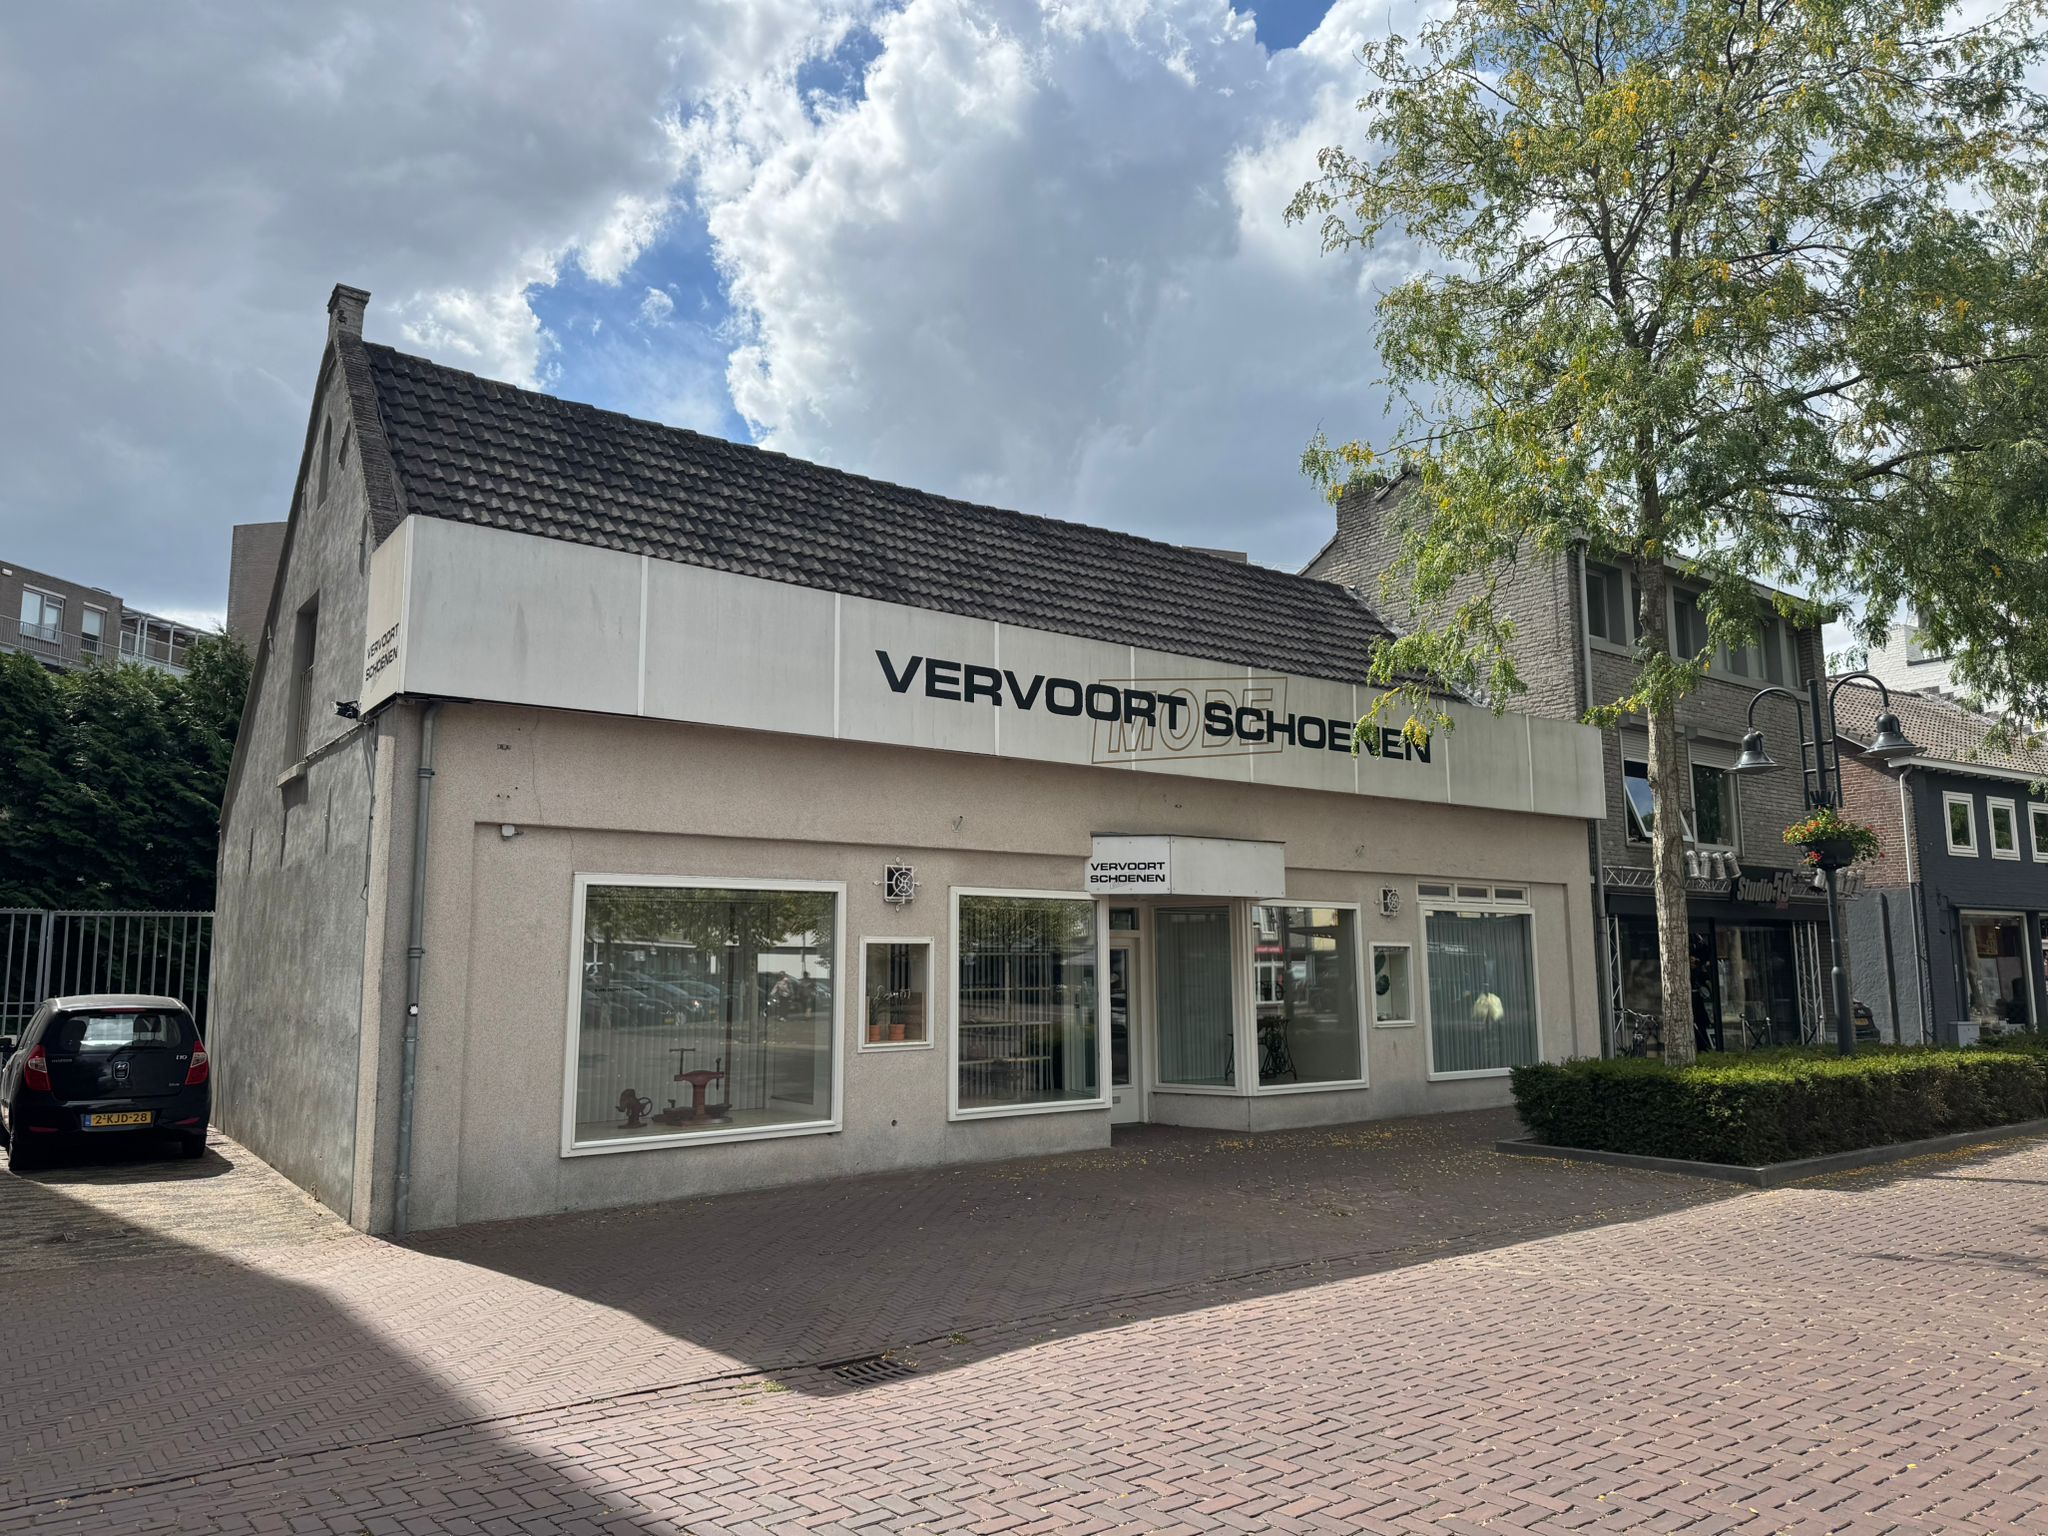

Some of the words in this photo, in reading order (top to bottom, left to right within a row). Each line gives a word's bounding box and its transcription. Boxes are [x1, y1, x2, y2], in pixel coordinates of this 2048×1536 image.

[367, 623, 399, 660] VERVOORT
[365, 645, 399, 681] SCHOENEN
[875, 650, 1188, 730] VERVOORT
[1108, 688, 1274, 754] MODE
[1090, 861, 1166, 871] VERVOORT
[1090, 874, 1166, 883] SCHOENEN
[95, 1113, 148, 1125] 2-KJD-28
